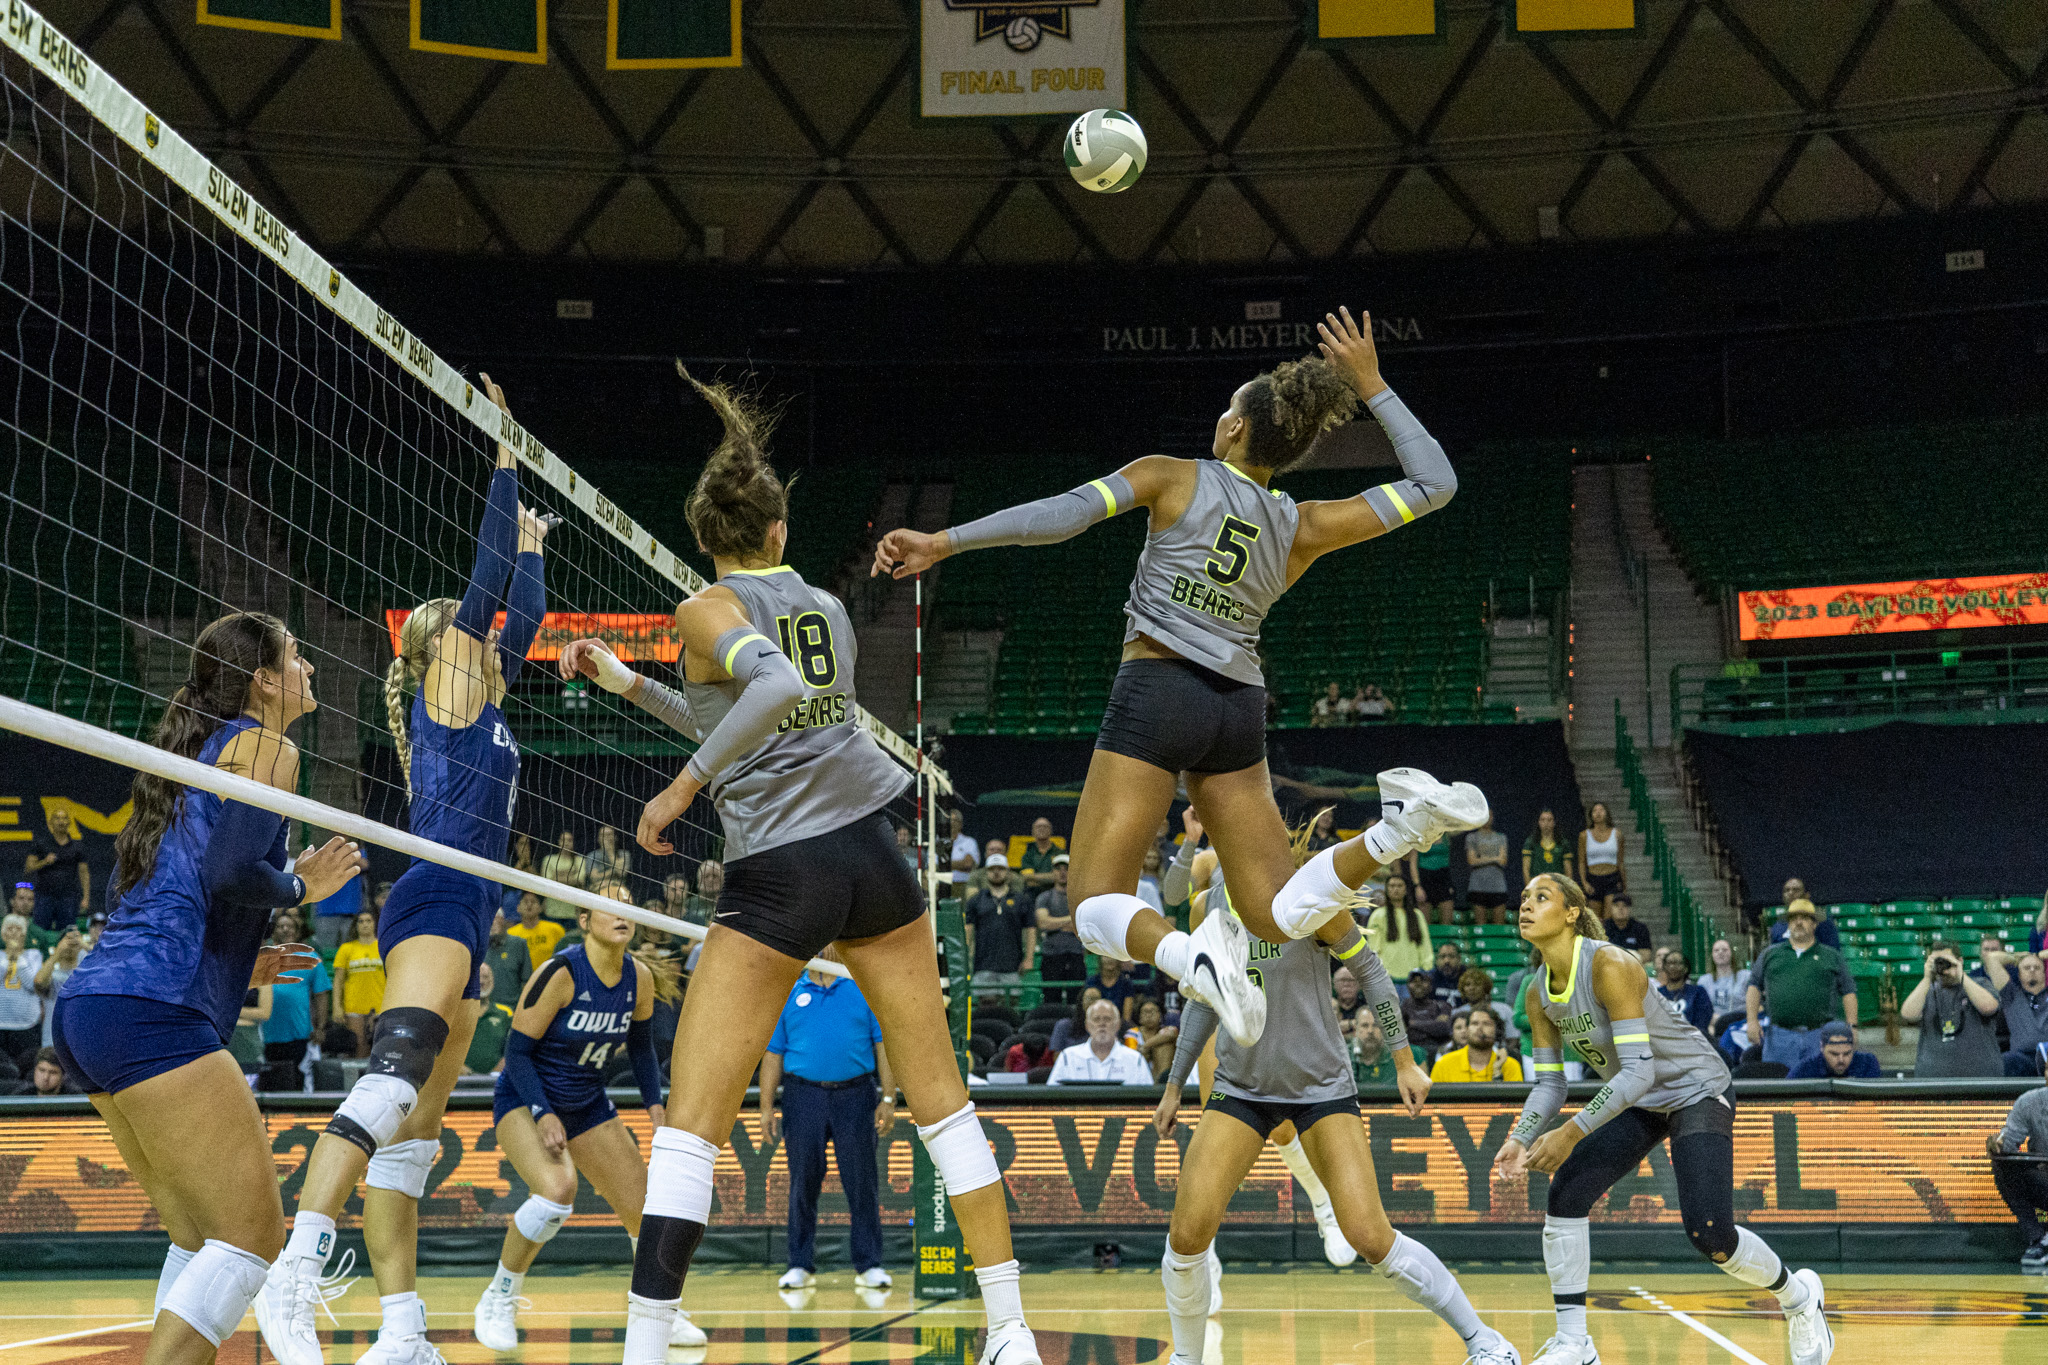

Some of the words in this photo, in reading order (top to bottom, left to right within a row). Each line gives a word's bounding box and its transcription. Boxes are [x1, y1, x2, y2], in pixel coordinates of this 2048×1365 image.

[39, 22, 89, 91] BEARS
[940, 71, 1024, 95] FINAL
[1031, 67, 1106, 92] FOUR
[254, 204, 289, 257] BEARS
[1102, 326, 1178, 351] PAUL
[1210, 324, 1313, 349] MEYER
[408, 333, 435, 378] BEARS
[525, 432, 546, 470] BEARS
[1204, 513, 1262, 587] 5
[1169, 573, 1246, 623] BEARS
[1754, 602, 1819, 623] 2023
[1826, 594, 1936, 618] BAYLOR
[775, 610, 838, 690] 18
[1248, 939, 1283, 962] LOR
[566, 1009, 633, 1034] OWLS
[1375, 1000, 1401, 1038] BEARS
[577, 1041, 613, 1070] 14
[1570, 1037, 1608, 1068] 15
[1584, 1085, 1614, 1116] BEARS
[920, 1260, 956, 1275] BEARS
